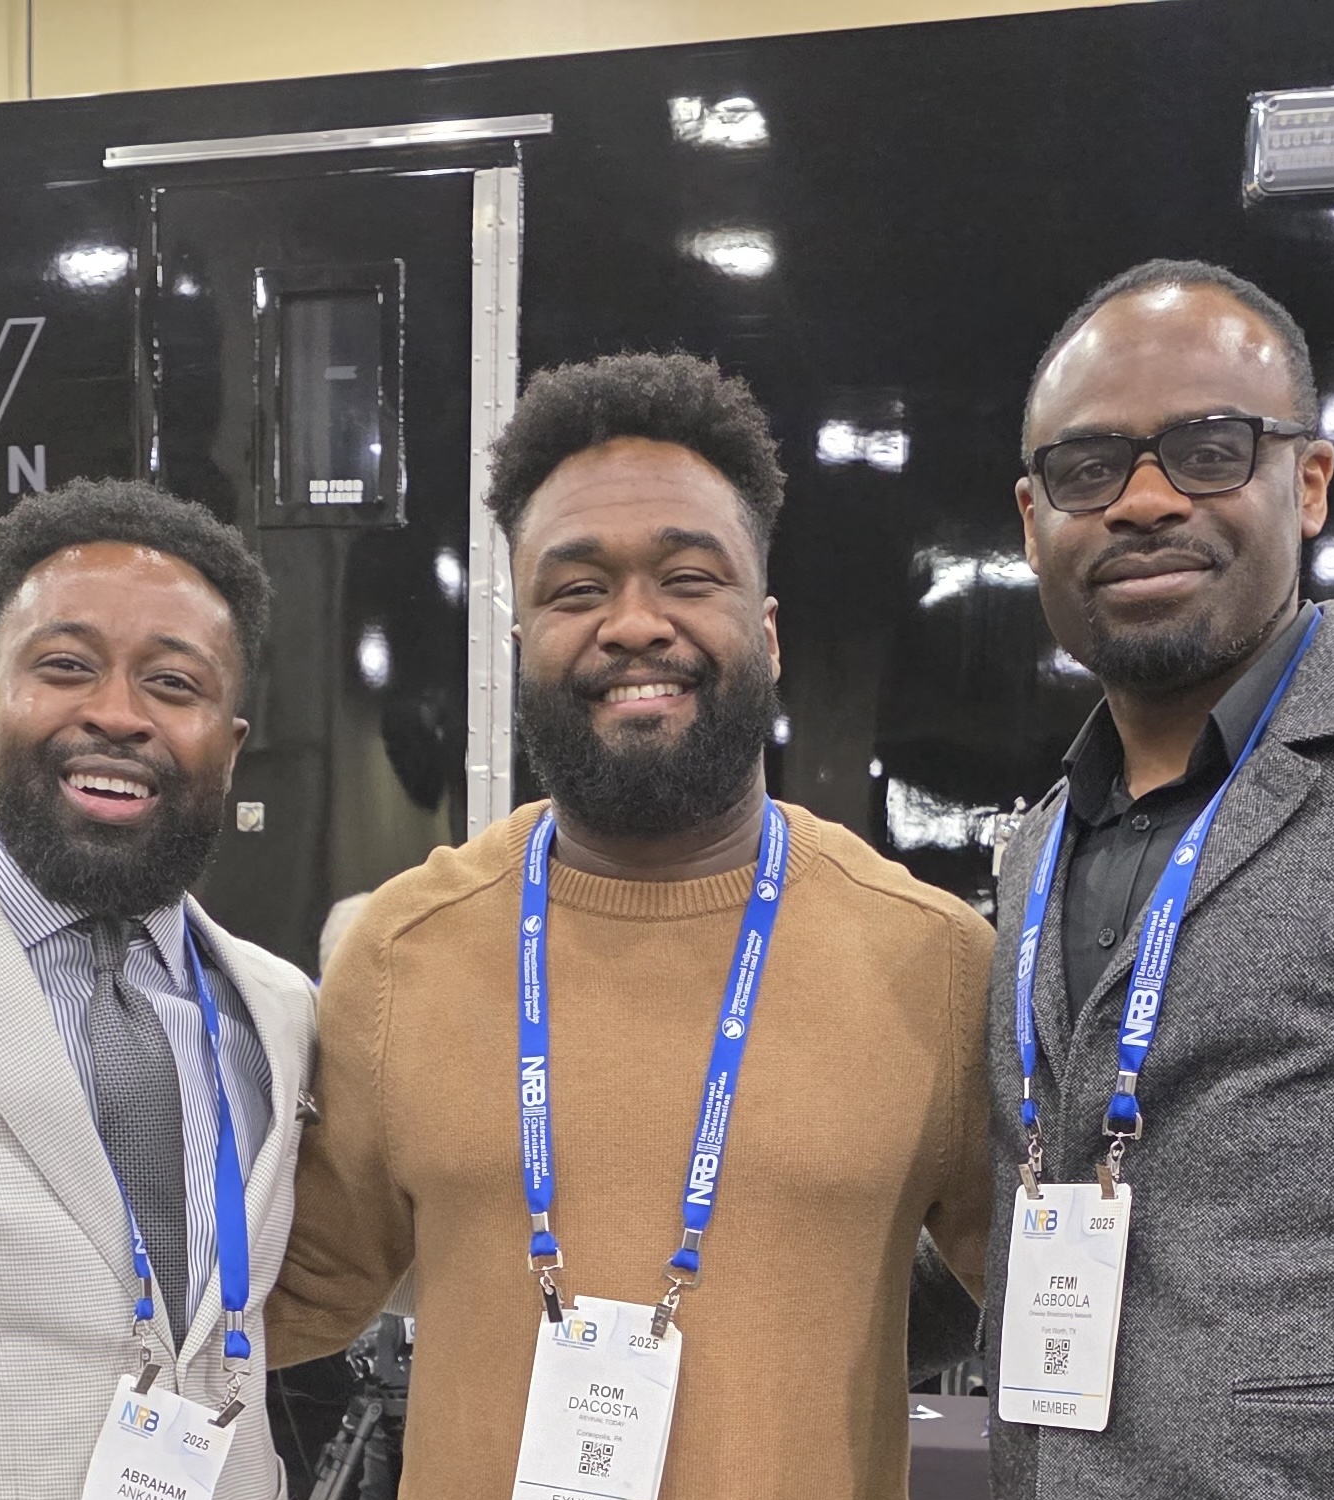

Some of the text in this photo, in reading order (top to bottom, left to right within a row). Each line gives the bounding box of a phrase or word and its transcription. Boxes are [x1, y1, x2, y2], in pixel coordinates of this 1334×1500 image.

[1018, 925, 1039, 979] NRB
[1136, 911, 1160, 977] International
[1146, 929, 1165, 978] Christian
[1158, 898, 1174, 928] Media
[1155, 921, 1176, 979] Convention
[1122, 989, 1158, 1048] NRB
[521, 1055, 546, 1107] NRB
[698, 1081, 717, 1142] International
[706, 1100, 721, 1144] Christian
[716, 1071, 728, 1100] Media
[714, 1094, 731, 1145] Convention
[522, 1118, 531, 1169] Convention
[531, 1117, 540, 1190] Christian Media
[539, 1116, 549, 1177] International
[687, 1153, 719, 1206] NRB
[1024, 1208, 1115, 1231] NRB 2025
[1033, 1293, 1090, 1308] AGBOOLA
[1049, 1276, 1078, 1290] FEMI
[555, 1319, 660, 1350] NRB 2025
[568, 1397, 639, 1420] DACOSTA
[590, 1383, 625, 1401] ROM
[1032, 1400, 1077, 1416] MEMBER
[120, 1400, 160, 1432] NRB
[182, 1432, 211, 1451] 2025
